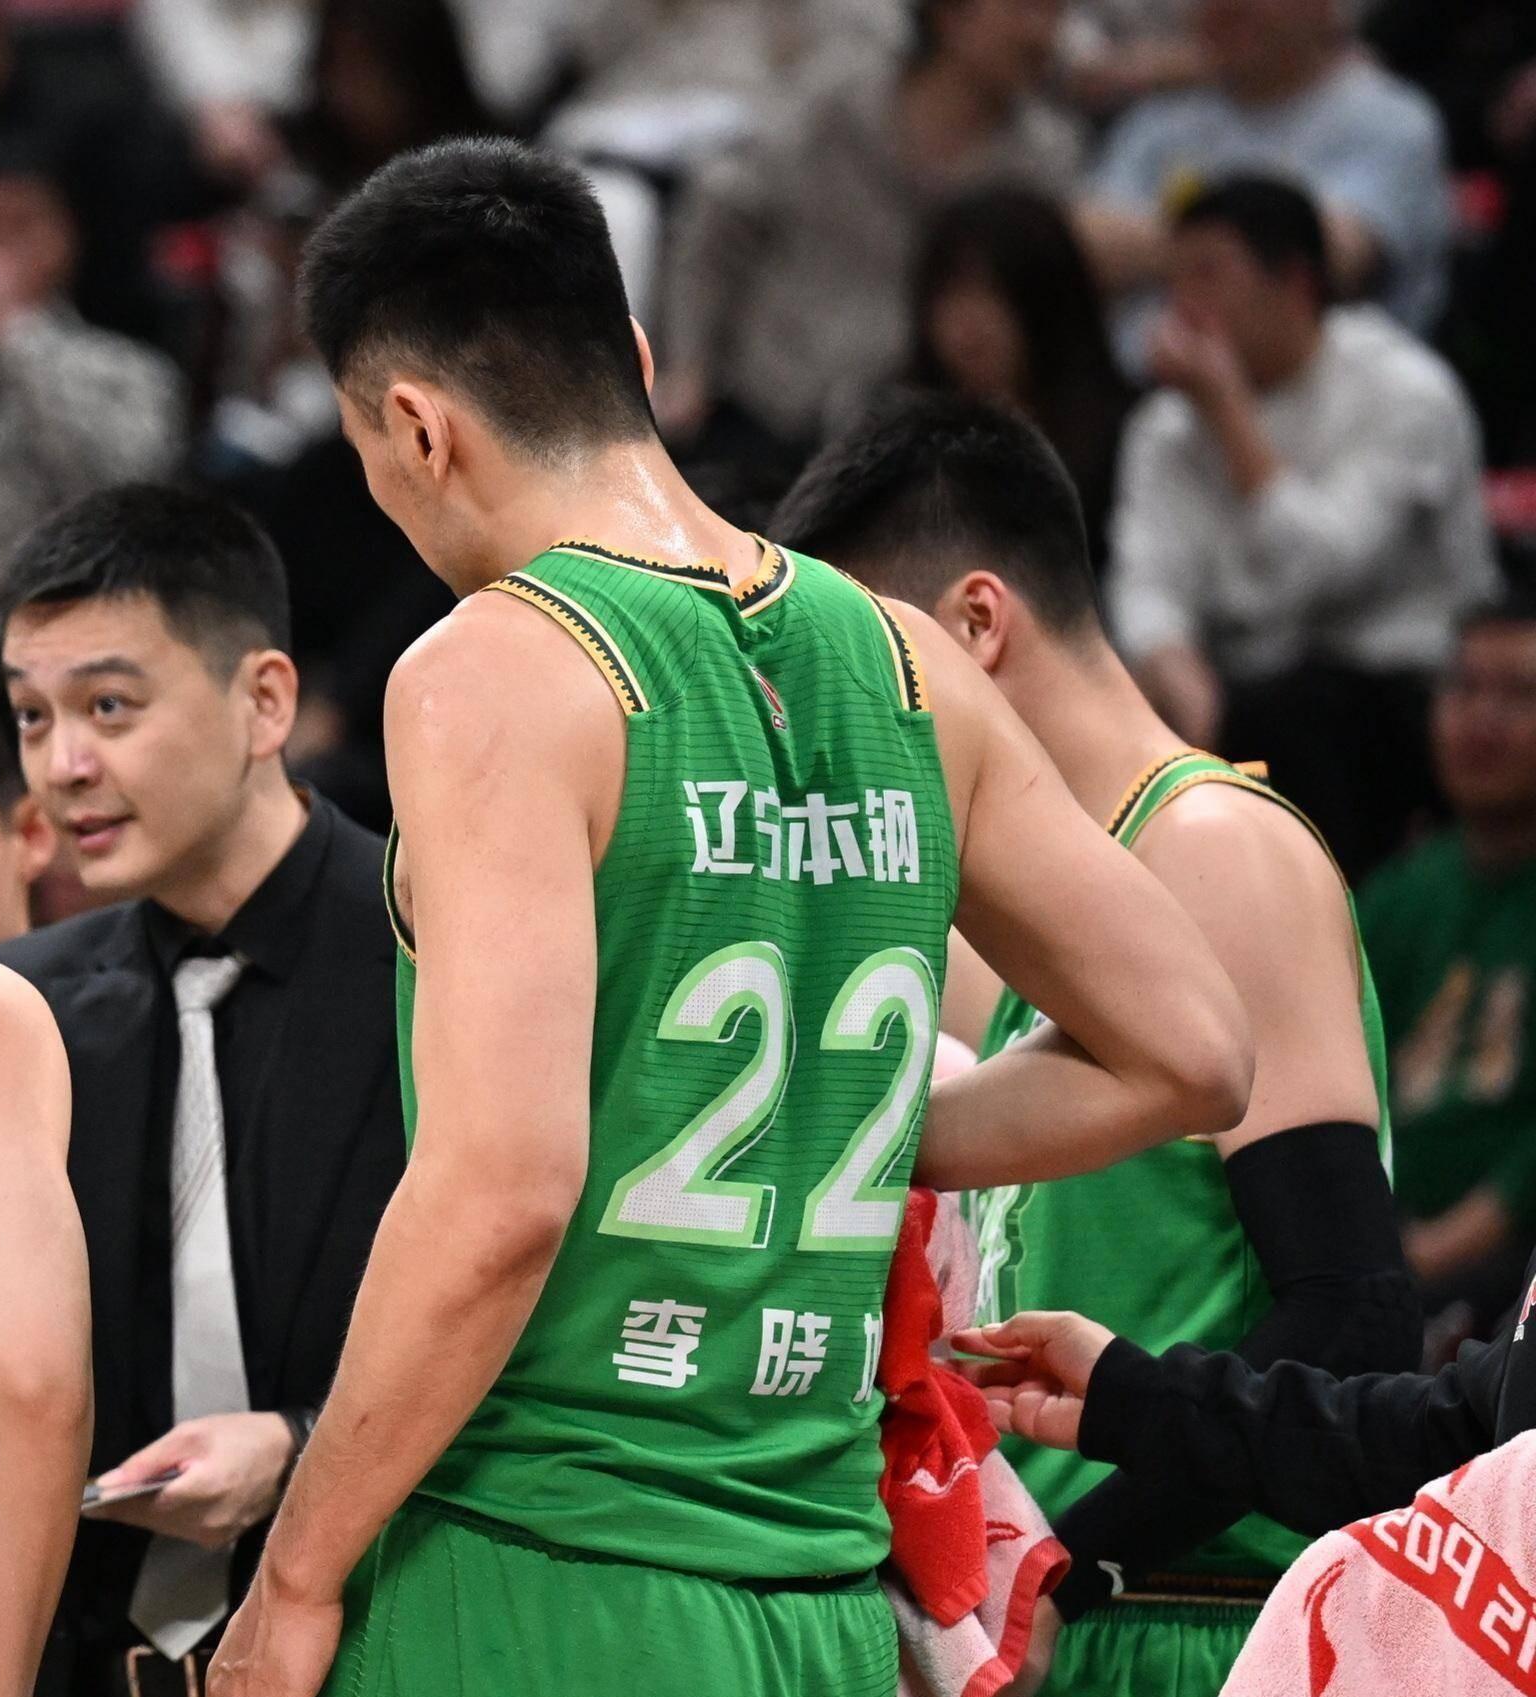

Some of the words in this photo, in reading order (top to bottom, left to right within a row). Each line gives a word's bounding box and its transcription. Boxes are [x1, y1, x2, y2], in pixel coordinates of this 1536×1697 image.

[681, 780, 920, 885] 辽宁本钢
[597, 941, 939, 1252] 22
